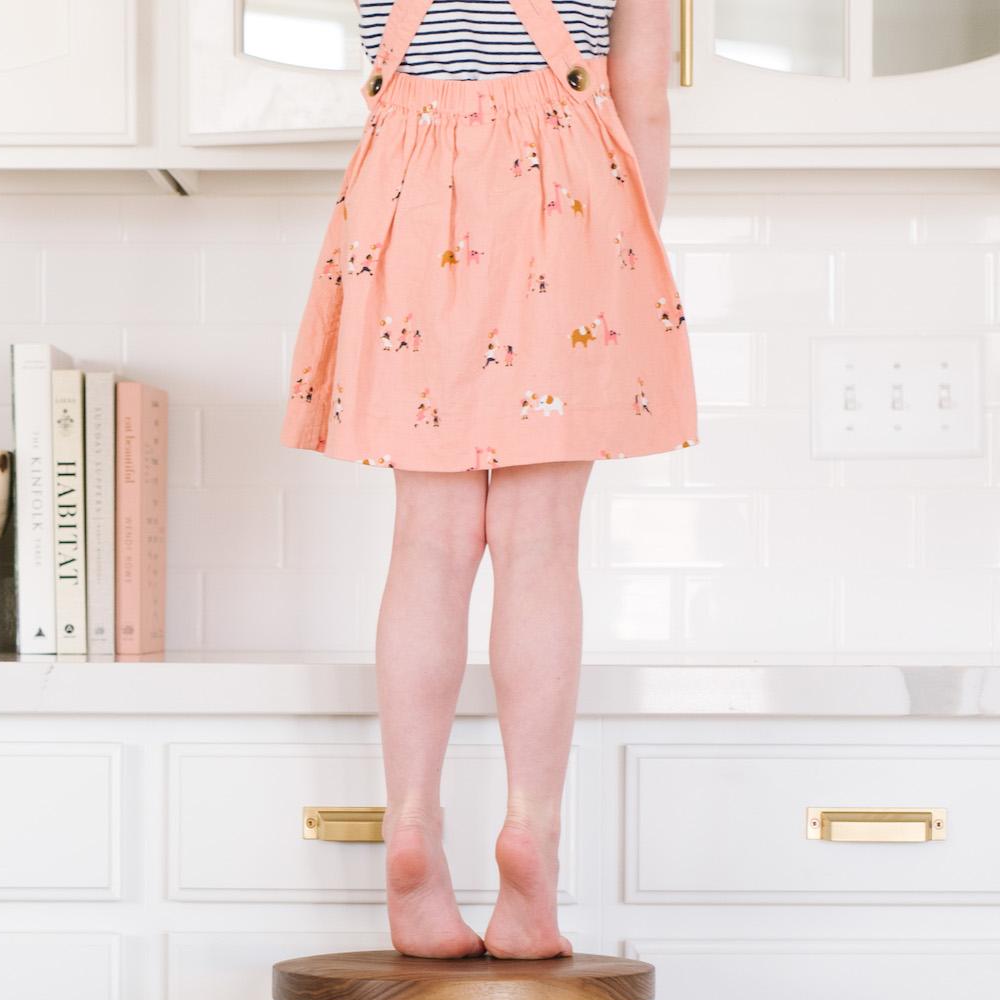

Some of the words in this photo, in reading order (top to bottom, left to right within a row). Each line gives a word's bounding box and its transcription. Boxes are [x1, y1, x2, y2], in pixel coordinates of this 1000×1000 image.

[31, 457, 43, 531] KINFOLK
[124, 435, 136, 484] beautiful
[56, 461, 79, 586] HABITAT
